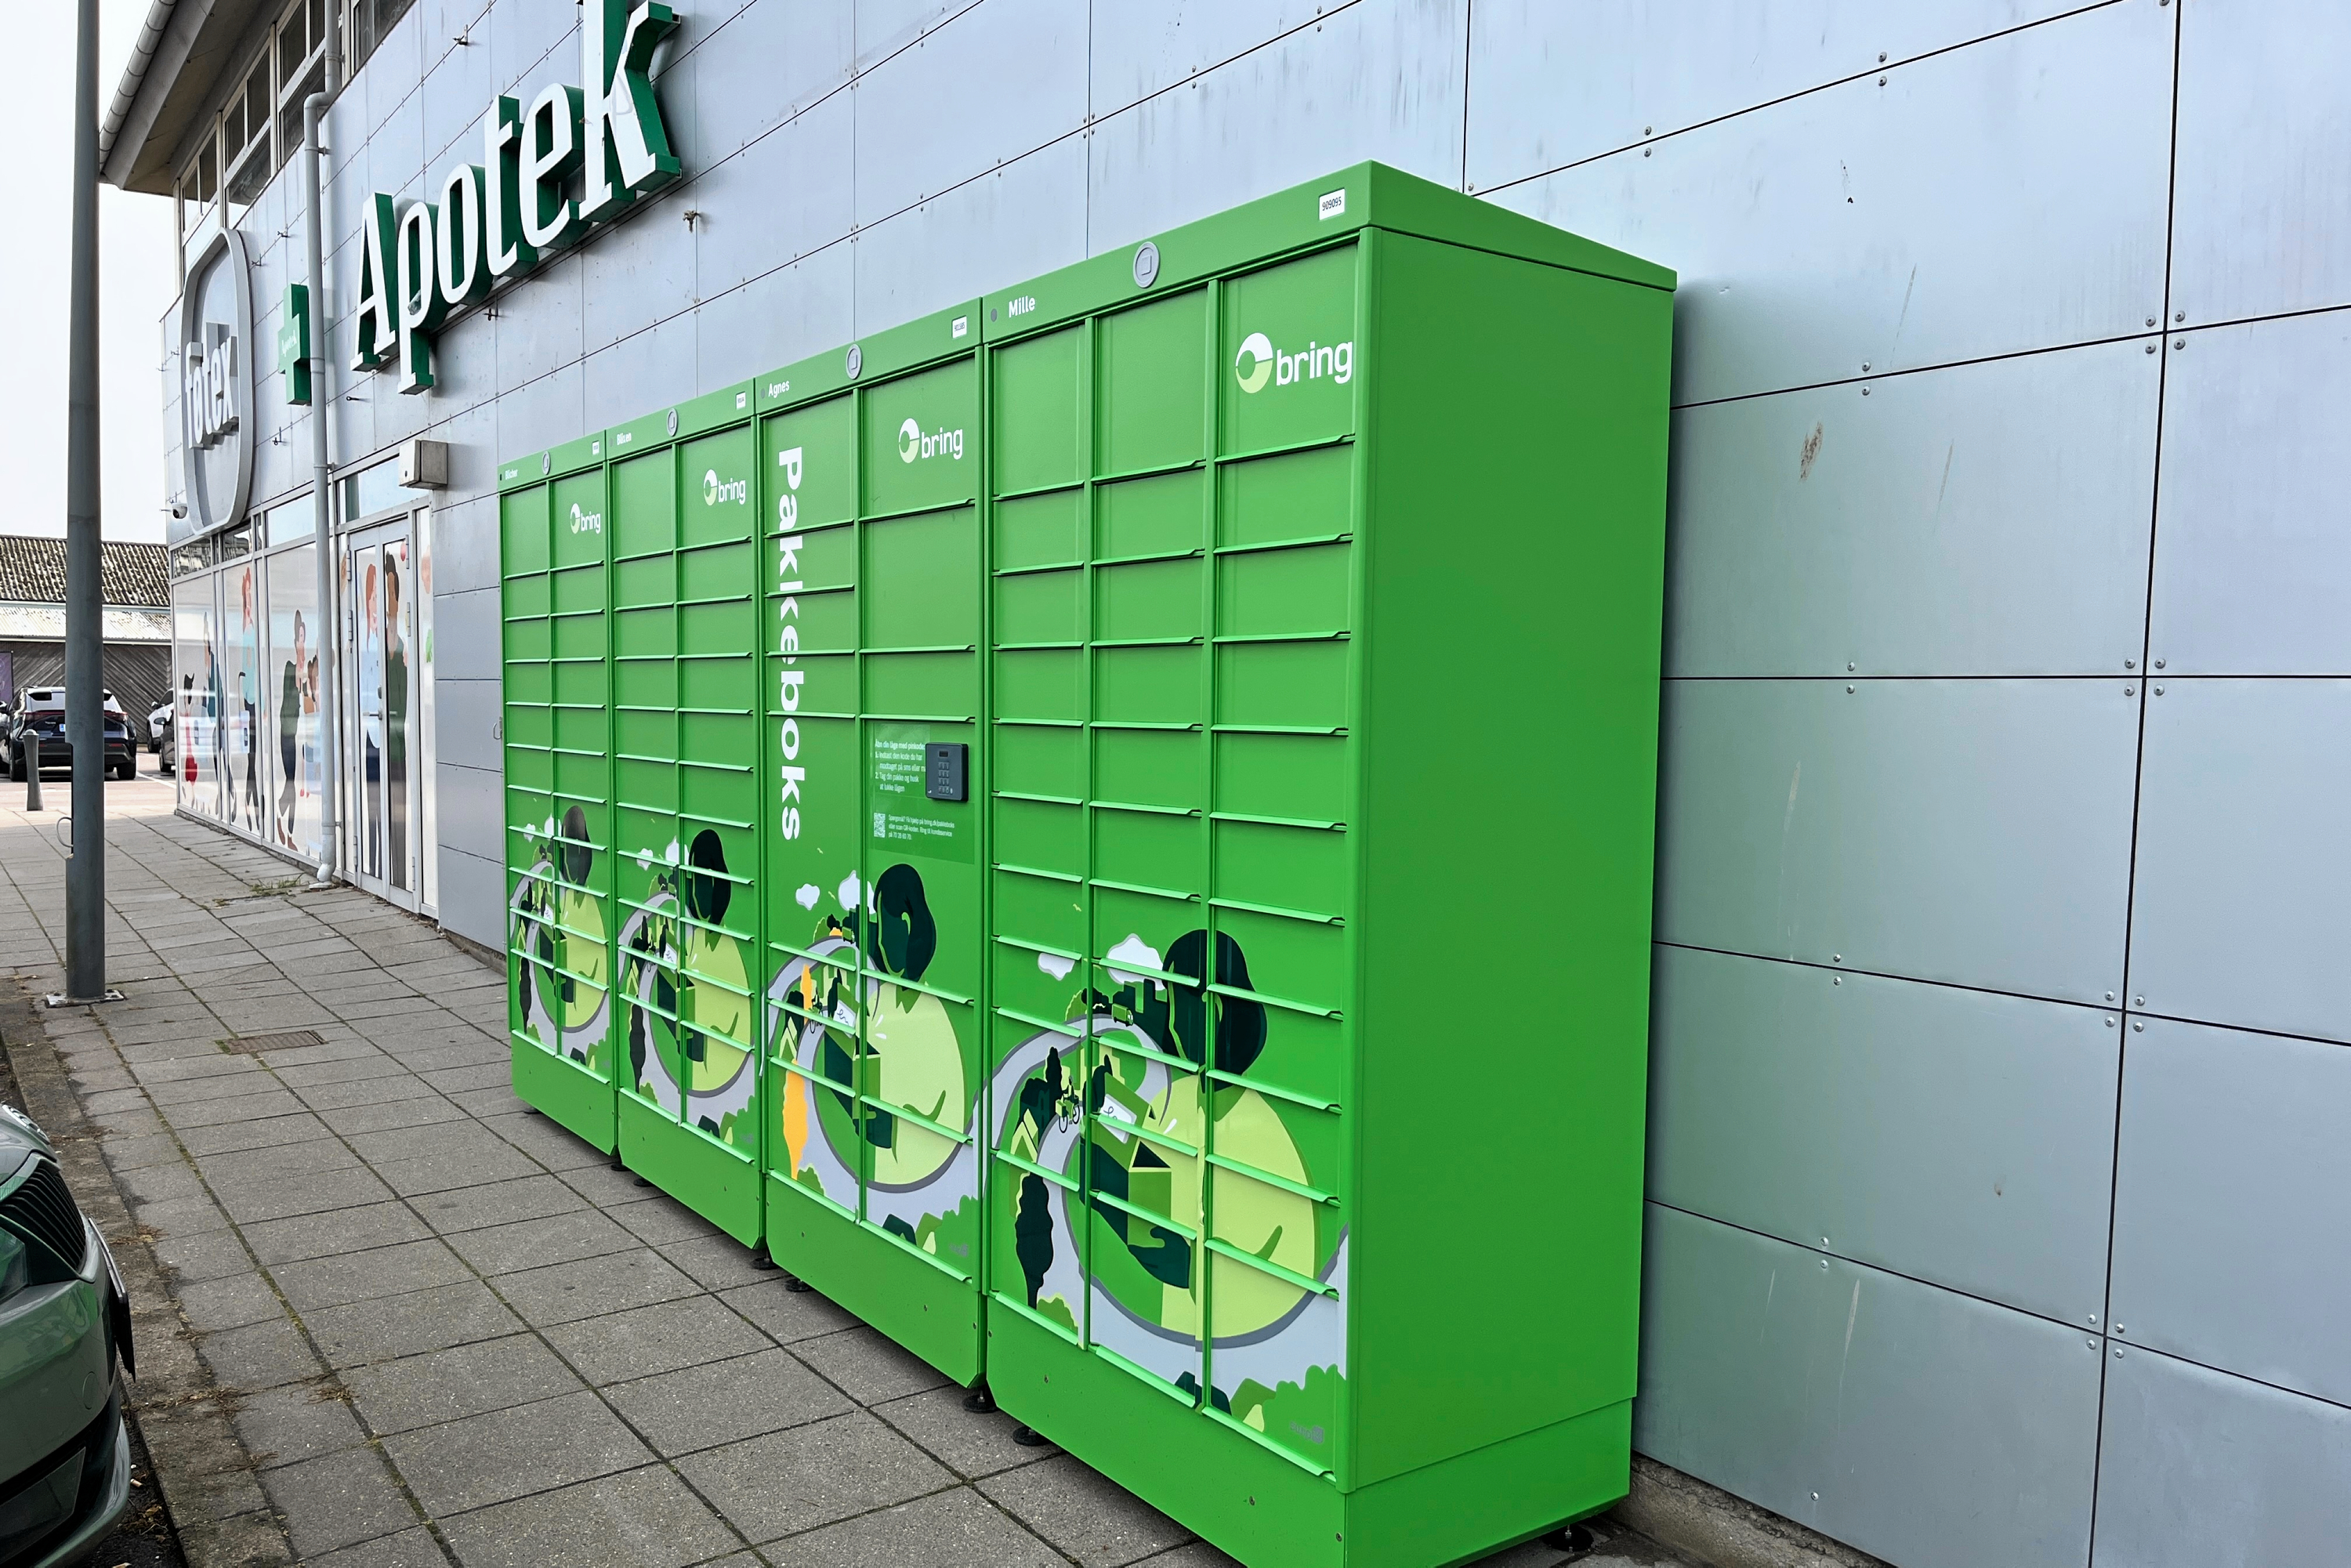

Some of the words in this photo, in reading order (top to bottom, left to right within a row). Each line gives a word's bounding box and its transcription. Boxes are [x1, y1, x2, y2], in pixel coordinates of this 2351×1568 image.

[350, 0, 680, 396] Apotek
[1322, 196, 1342, 211] 909095
[1008, 295, 1035, 319] Mille
[1276, 341, 1353, 386] bring
[184, 321, 238, 450] føtex
[768, 380, 790, 399] Agnes
[921, 426, 963, 460] bring
[718, 477, 746, 505] bring
[581, 511, 601, 534] bring
[779, 446, 806, 842] Pakkeboks
